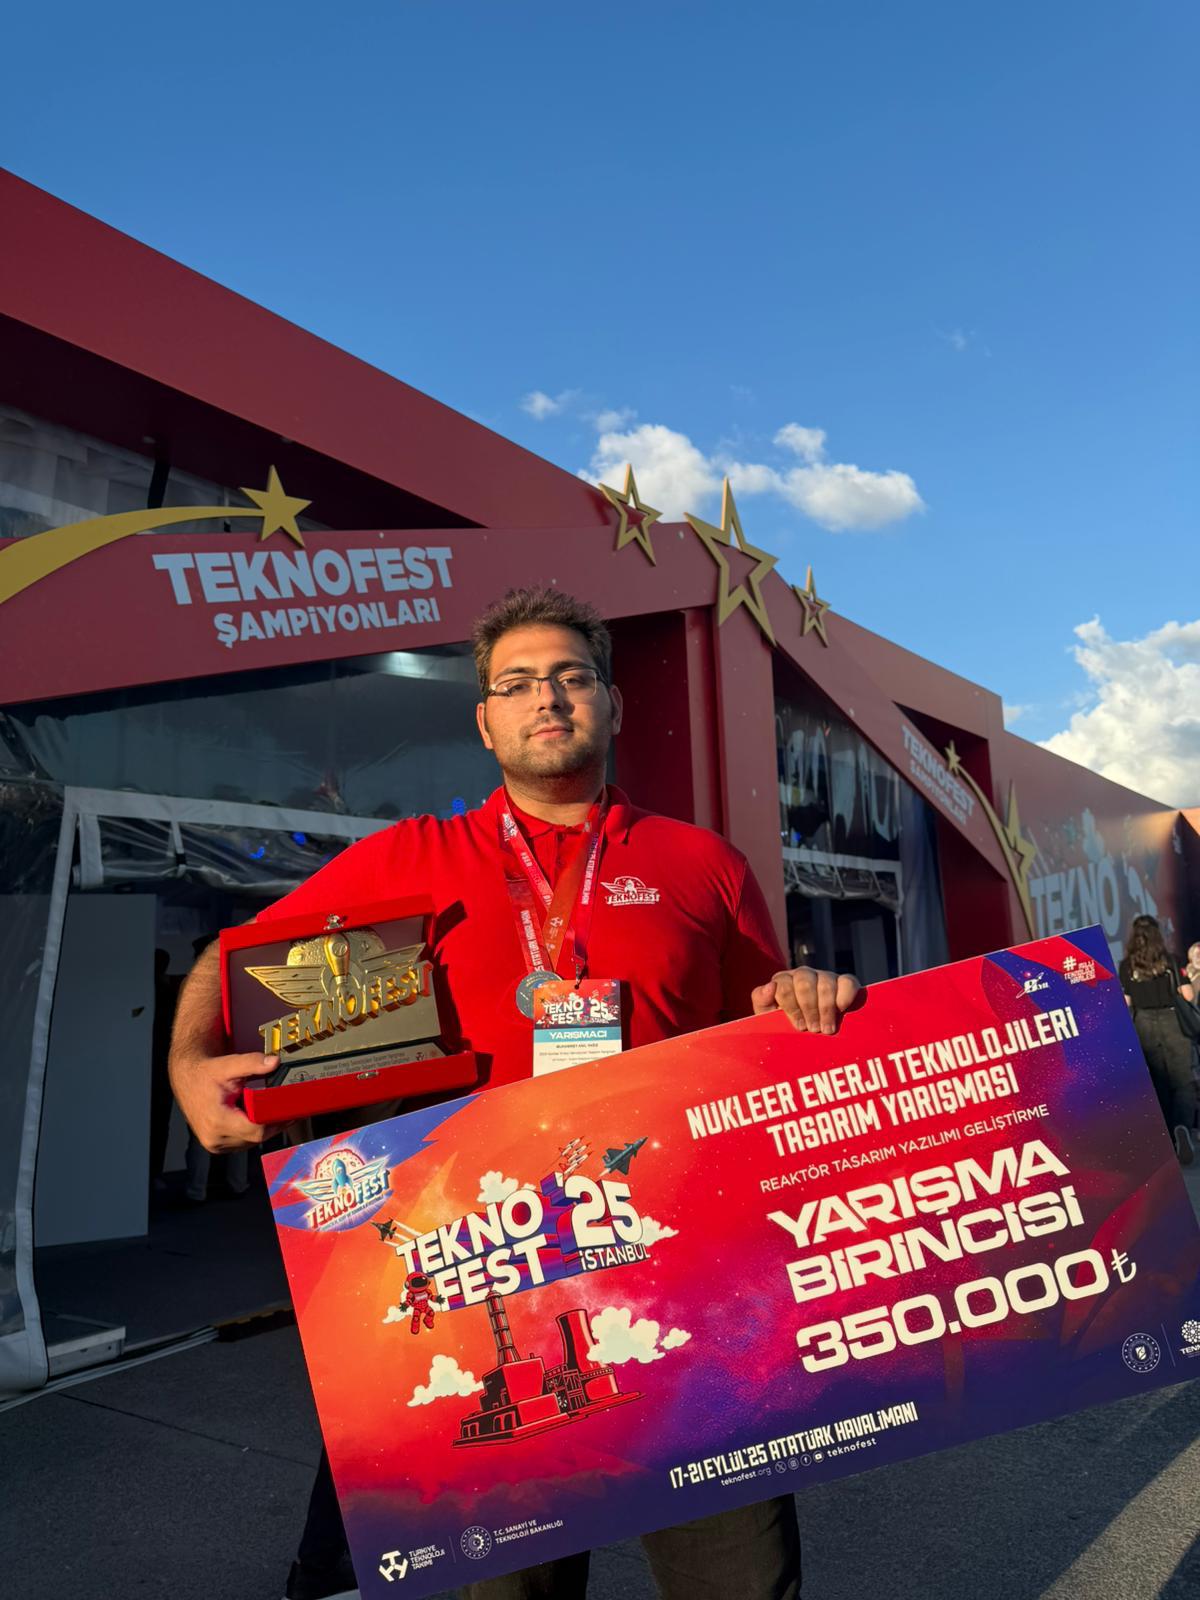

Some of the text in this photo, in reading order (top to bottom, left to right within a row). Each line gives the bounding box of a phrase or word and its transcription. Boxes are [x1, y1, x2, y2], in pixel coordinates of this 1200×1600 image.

[152, 547, 453, 605] TEKNOFEST
[902, 725, 975, 816] TEKNOFEST
[604, 892, 661, 905] TEKNOFEST
[1029, 857, 1121, 937] TEKNO
[258, 959, 434, 1057] TEKNOFEST
[543, 997, 585, 1014] TEKNO
[551, 1011, 584, 1025] FEST
[685, 1007, 1080, 1140] NÜKLEER ENERJİ TEKNOLOJİLERİ
[766, 1062, 1020, 1157] TASARIM YARIŞMASI
[760, 1104, 1050, 1192] REAKTÖR TASARIM YAZILIMI GELİŞTİRME
[306, 1167, 391, 1229] TEKNOFEST
[396, 1188, 544, 1275] TEKNO
[767, 1139, 1071, 1249] YARIŞMA
[434, 1233, 548, 1313] FEST
[785, 1185, 1085, 1303] BİRİNCİSİ
[669, 1463, 704, 1489] 17-21
[768, 1424, 835, 1461] ATATÜRK
[834, 1401, 919, 1443] HAVALİMANI
[720, 1437, 878, 1487] teknofest.org teknofest
[528, 1519, 538, 1527] VE
